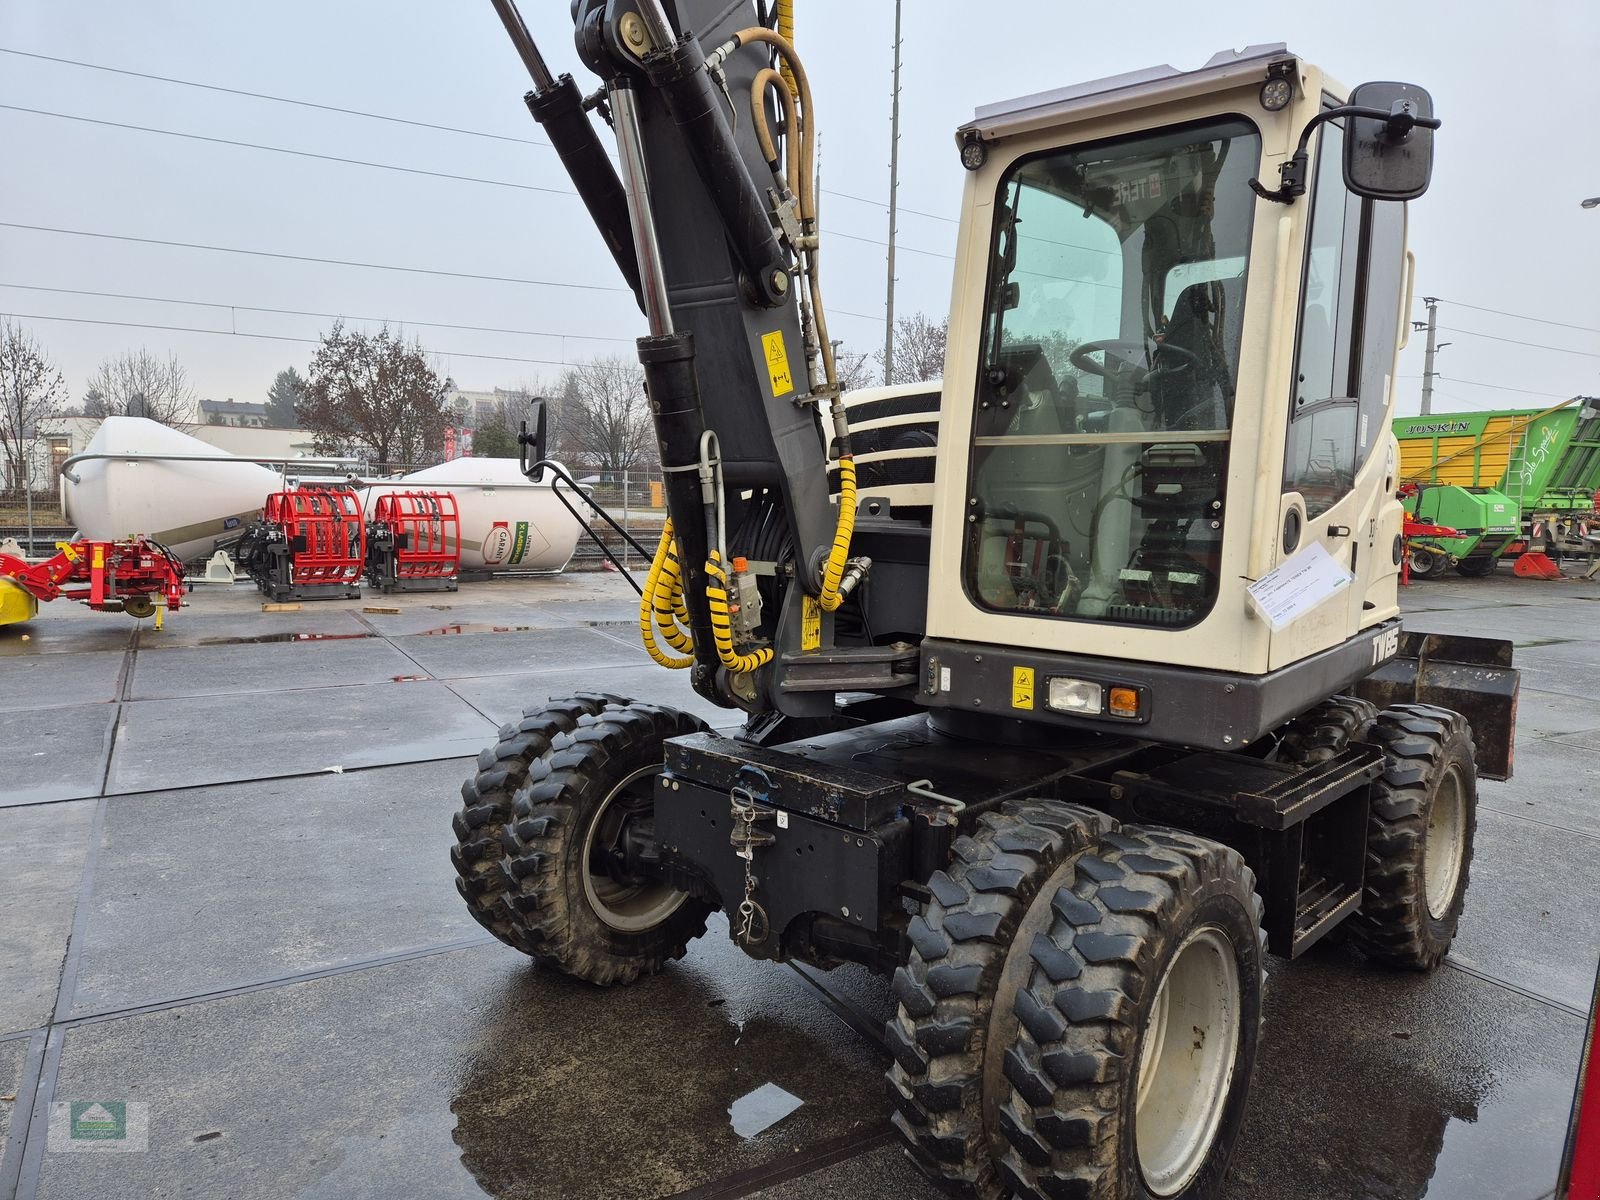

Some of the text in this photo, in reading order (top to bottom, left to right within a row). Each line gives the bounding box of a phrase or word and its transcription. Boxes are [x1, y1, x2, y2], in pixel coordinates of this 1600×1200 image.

[1406, 421, 1470, 434] JOSKIN
[495, 531, 508, 560] GARANT
[523, 534, 533, 557] UNSER
[1371, 626, 1400, 666] TW85
